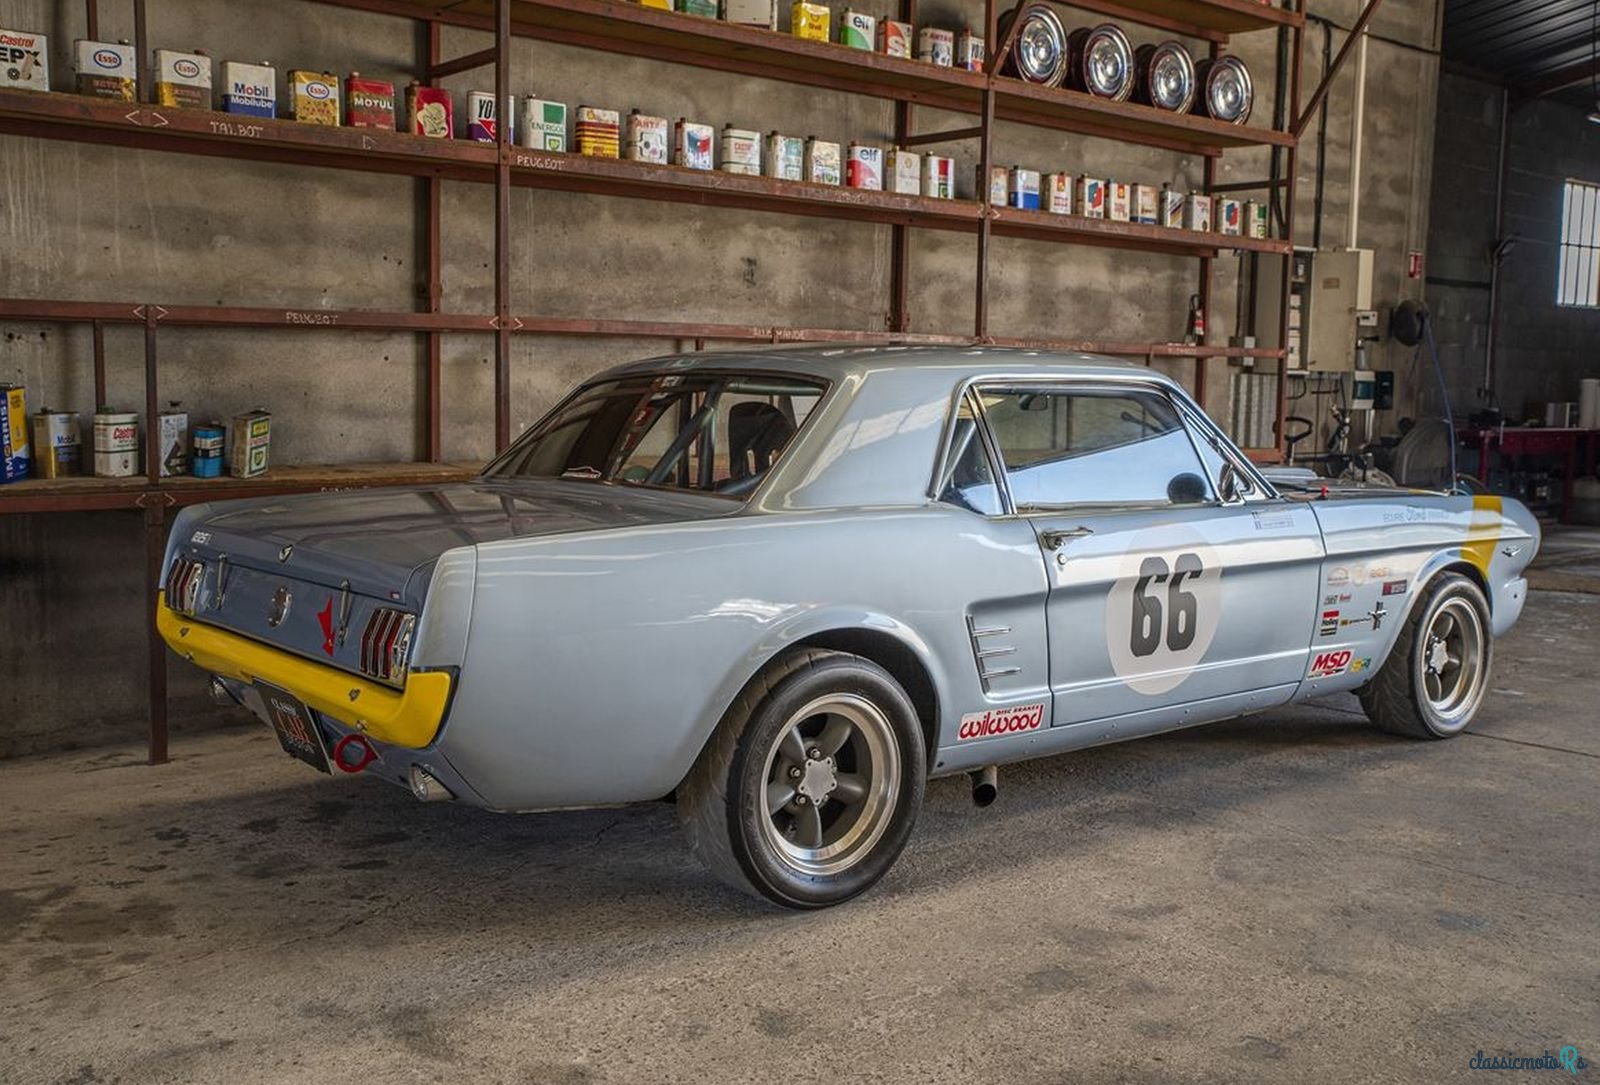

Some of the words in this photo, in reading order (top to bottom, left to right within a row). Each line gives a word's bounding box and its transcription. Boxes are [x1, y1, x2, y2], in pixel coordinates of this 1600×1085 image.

[98, 54, 118, 64] Esso
[178, 63, 196, 74] Esso
[233, 82, 269, 98] Mobil
[309, 85, 327, 96] Esso
[230, 96, 273, 109] Mobilube
[352, 97, 393, 111] MOTUL
[209, 121, 264, 138] TALBOT
[516, 154, 564, 171] PEUGEOT
[859, 148, 877, 163] elf
[1130, 553, 1203, 658] 66
[1311, 651, 1352, 672] MSD
[959, 703, 1044, 739] wilwood
